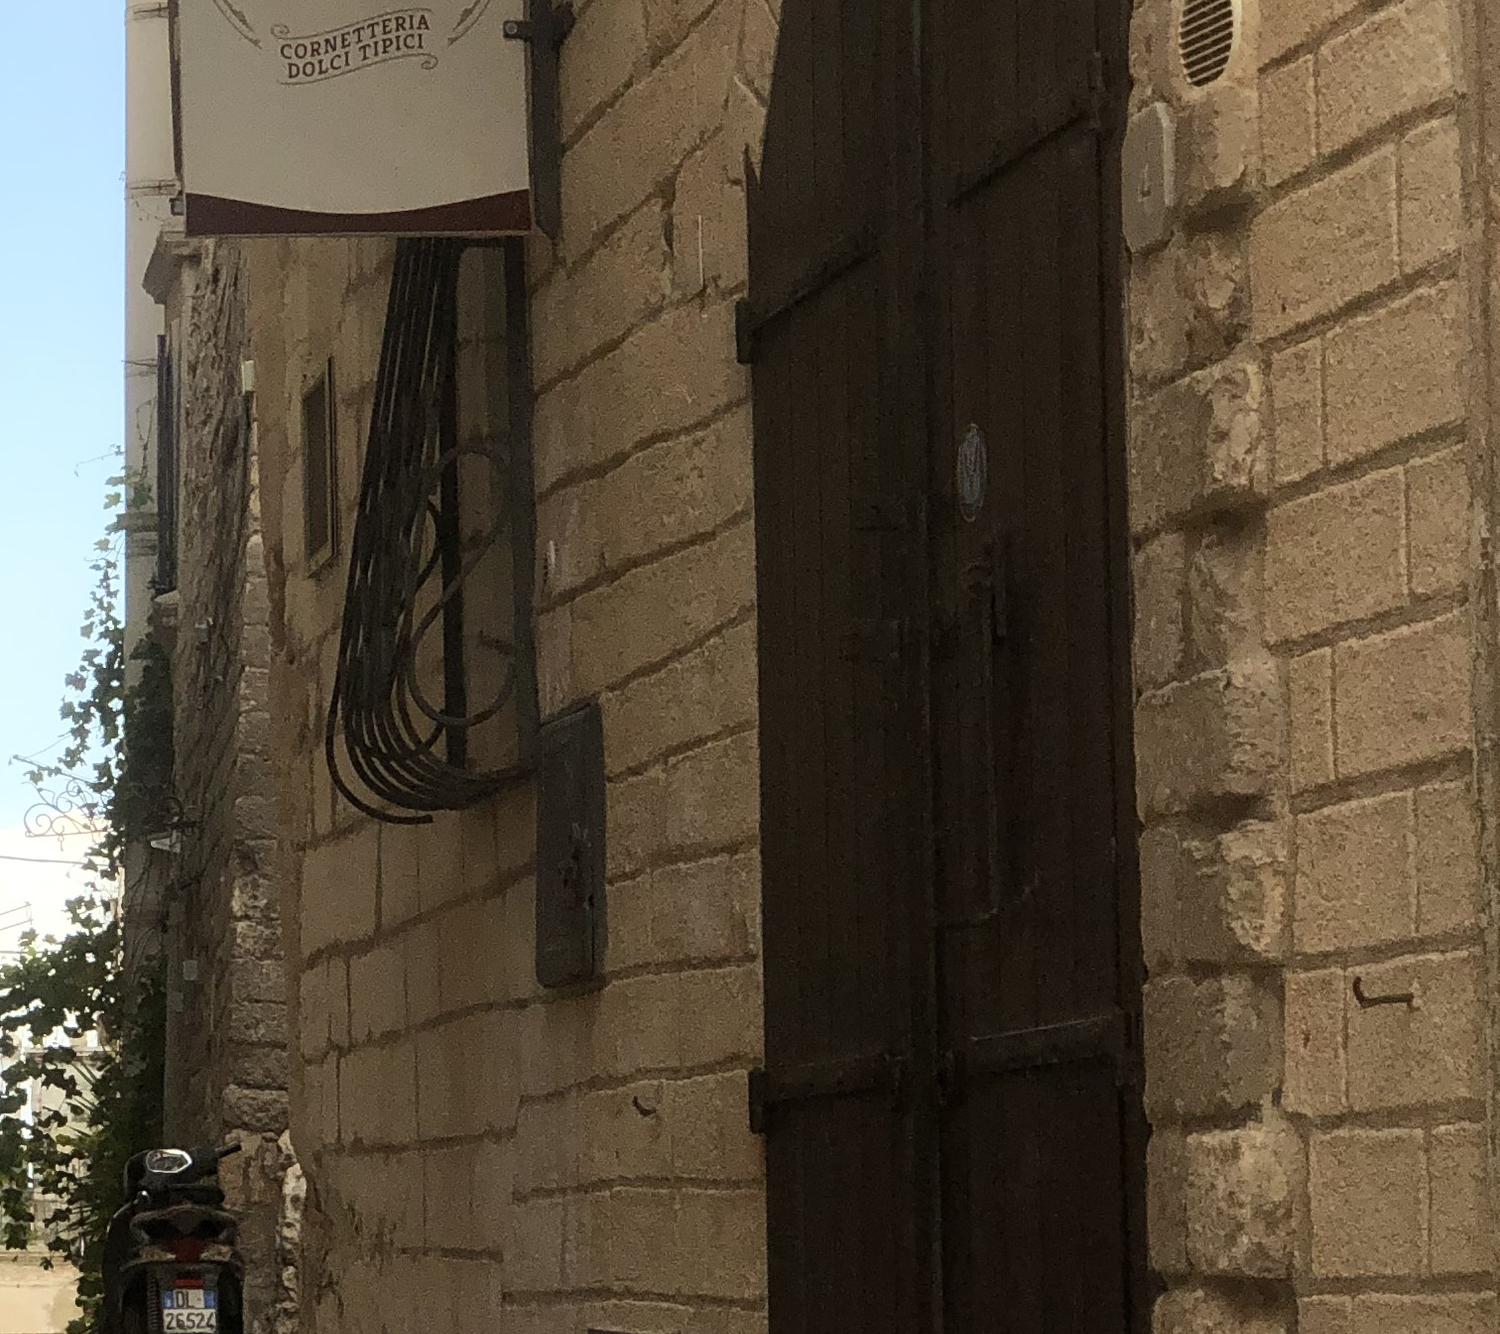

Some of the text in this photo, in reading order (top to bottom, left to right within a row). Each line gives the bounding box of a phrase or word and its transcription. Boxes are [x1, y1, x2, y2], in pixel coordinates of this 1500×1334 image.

[280, 14, 430, 60] CORNETTERIA
[288, 33, 424, 79] DOLCI TIPICI
[175, 1290, 195, 1309] DL
[165, 1312, 215, 1330] 26524
